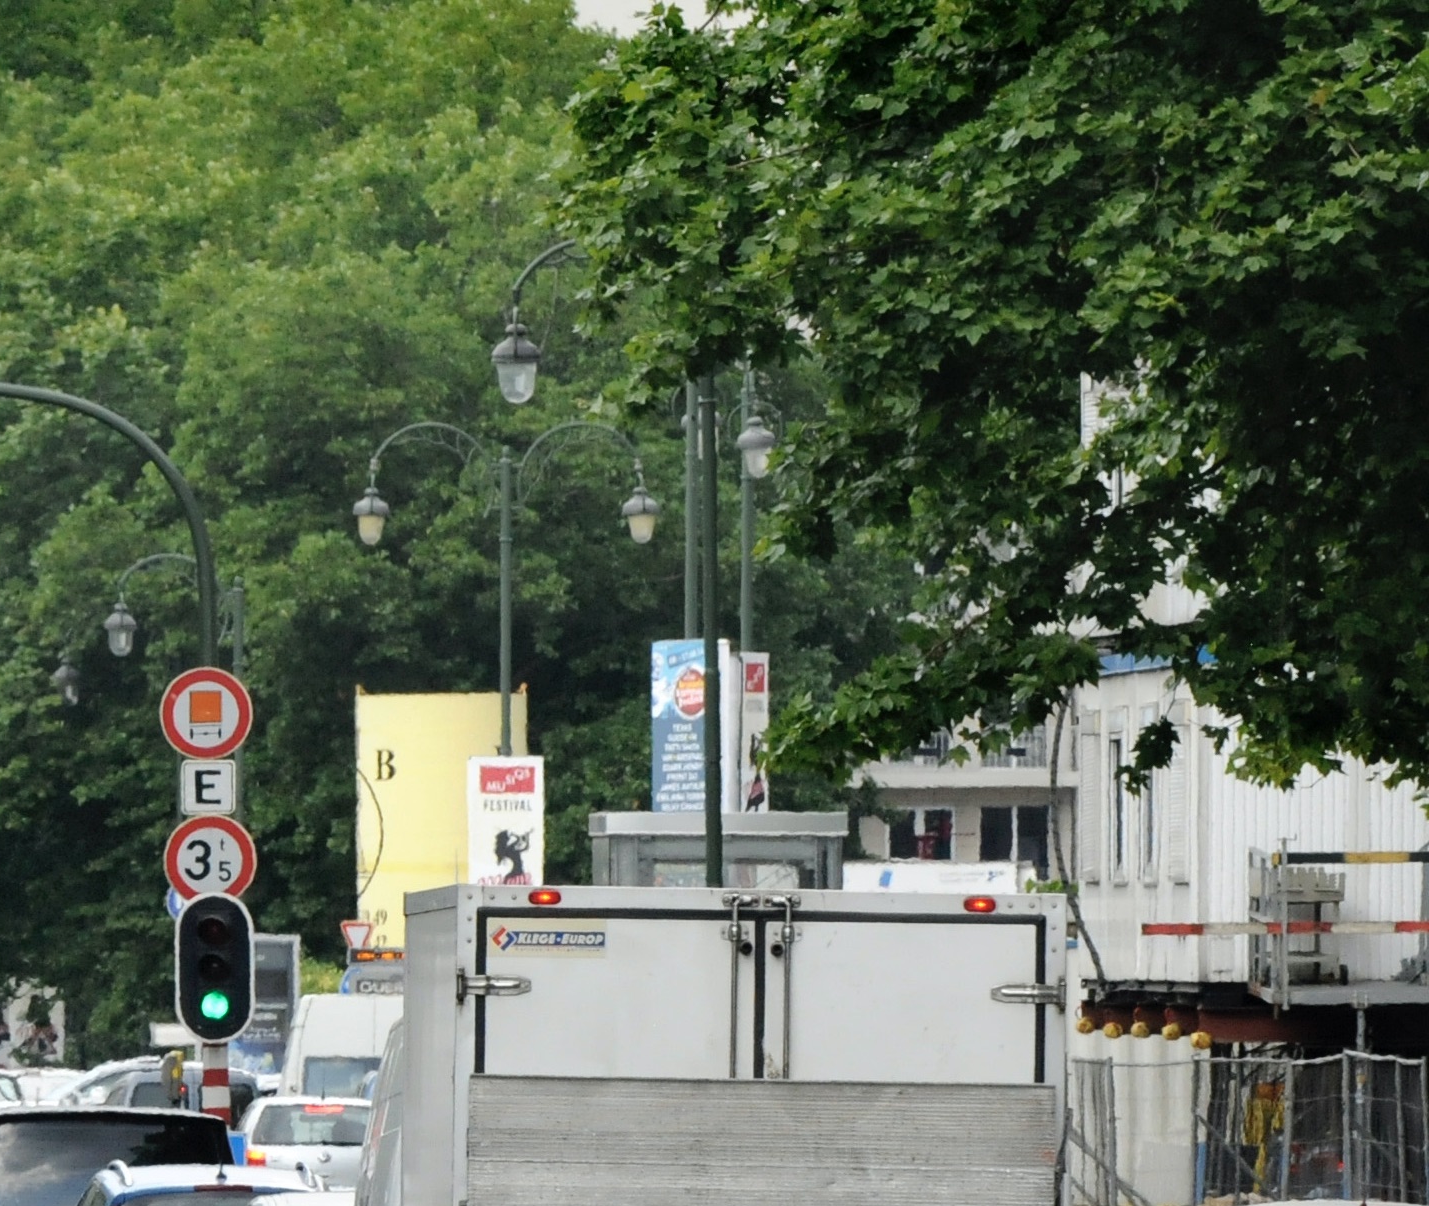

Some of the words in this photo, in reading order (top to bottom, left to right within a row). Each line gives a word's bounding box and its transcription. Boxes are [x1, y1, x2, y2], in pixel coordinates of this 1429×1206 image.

[375, 750, 396, 781] B
[195, 770, 221, 804] E
[483, 799, 533, 812] FESTIVAL
[184, 839, 211, 881] 3
